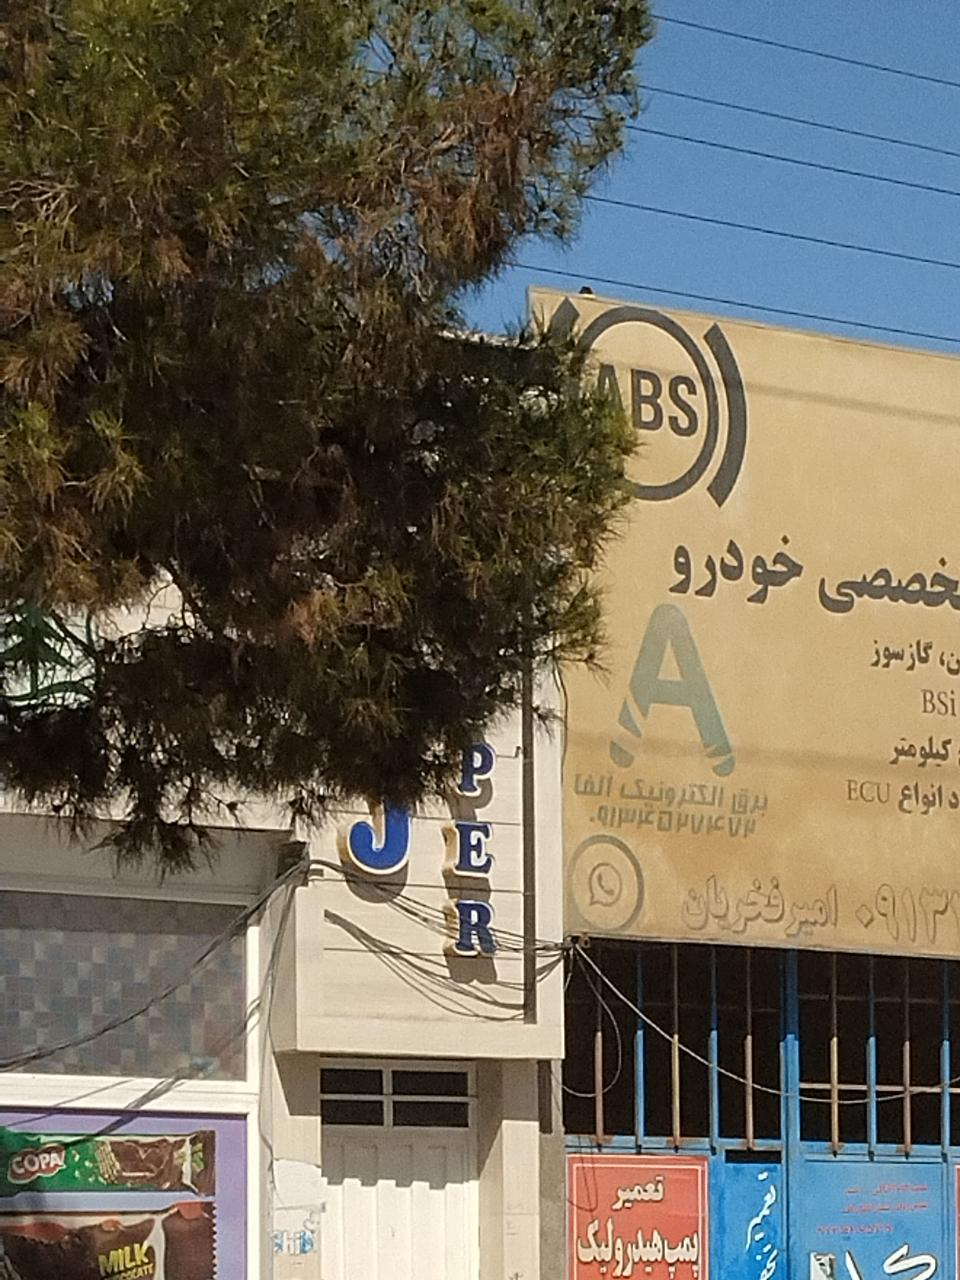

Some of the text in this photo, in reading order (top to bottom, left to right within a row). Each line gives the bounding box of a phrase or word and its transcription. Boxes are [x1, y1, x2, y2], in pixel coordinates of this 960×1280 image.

[596, 362, 698, 437] ABS
[668, 535, 804, 604] خودرو
[889, 737, 952, 768] کیلومتر
[620, 778, 724, 808] الکترونیک
[731, 788, 768, 817] برق
[846, 779, 890, 804] ECU
[898, 780, 943, 815] انواع
[785, 884, 838, 938] امیر
[11, 1152, 64, 1174] COPA
[612, 1175, 664, 1211] تعمیر
[98, 1243, 150, 1277] MILK
